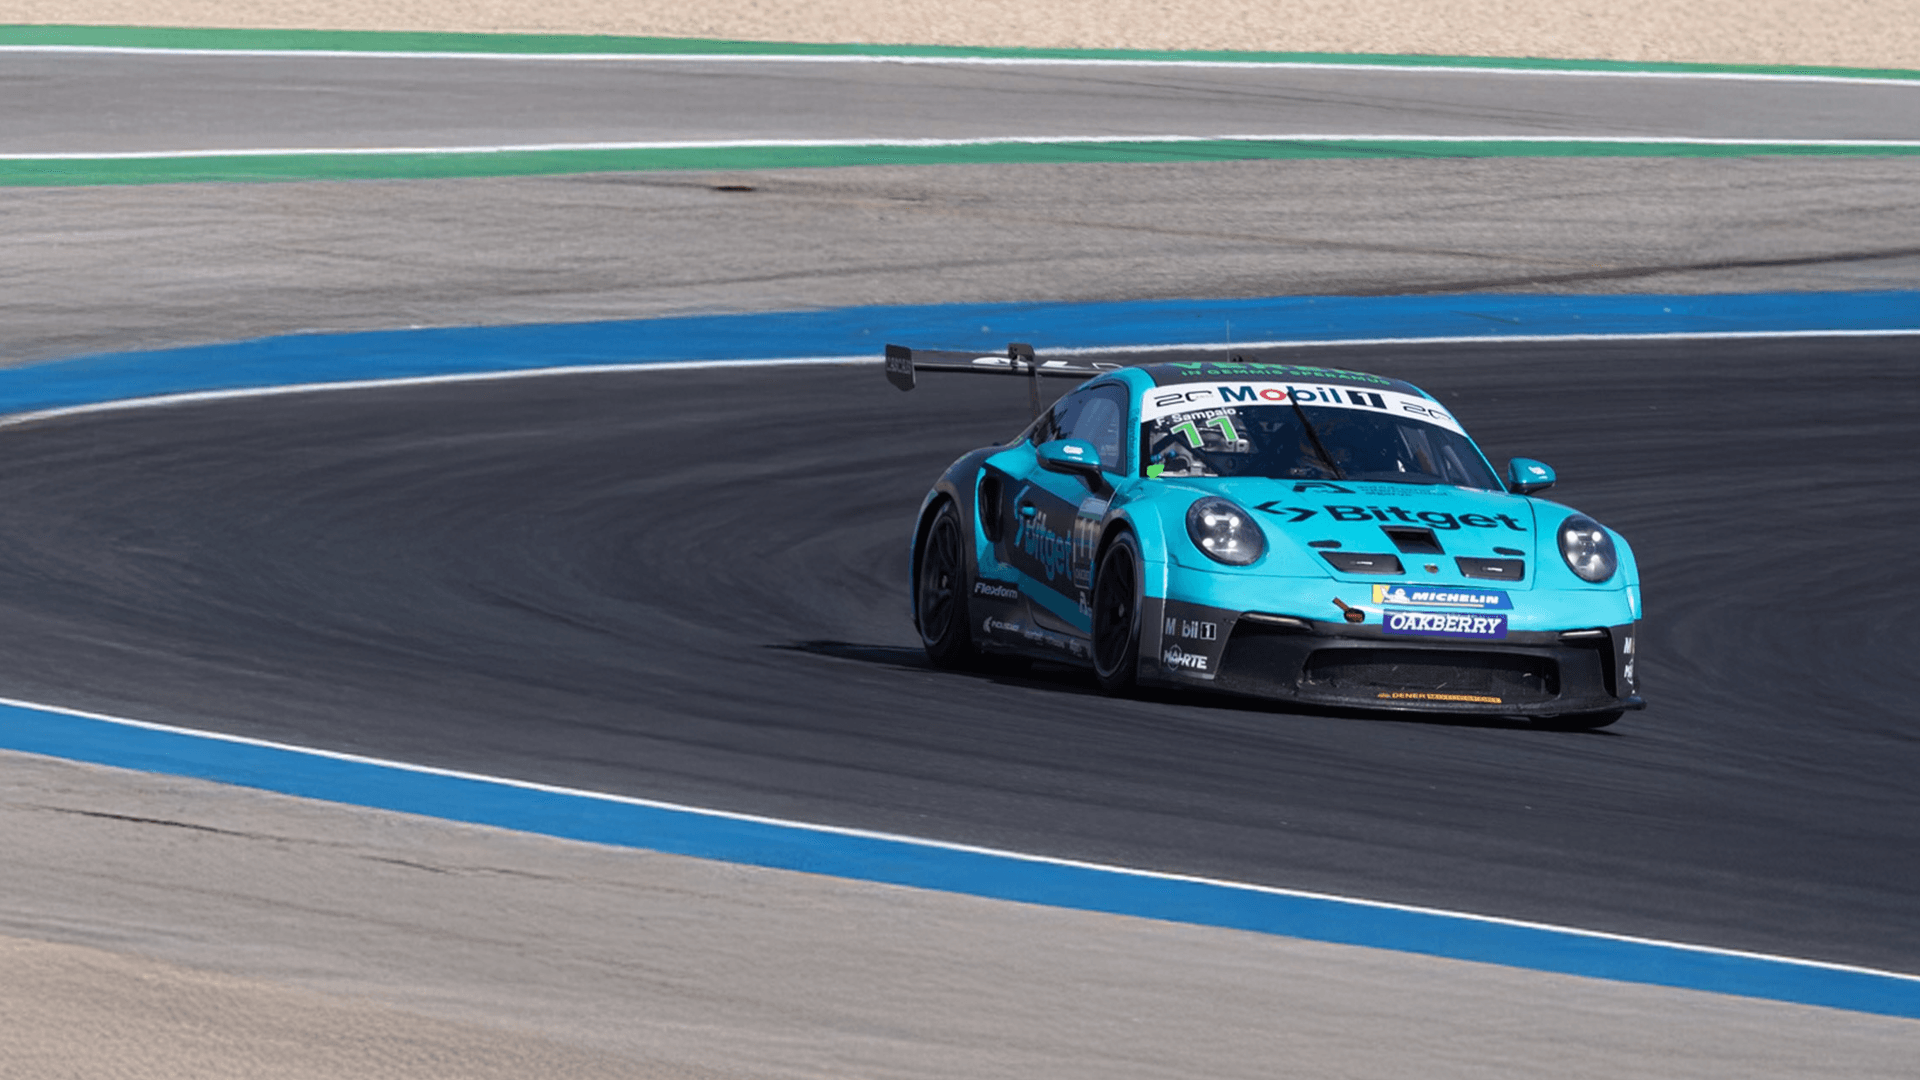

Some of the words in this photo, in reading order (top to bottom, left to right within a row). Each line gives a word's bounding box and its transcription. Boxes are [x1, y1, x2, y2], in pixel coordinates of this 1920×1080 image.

[1217, 385, 1343, 404] Mobil
[1171, 406, 1237, 423] Sampaio
[1170, 415, 1239, 449] 11
[1323, 504, 1527, 532] Bitget
[974, 582, 1018, 600] Flexform
[1411, 591, 1499, 604] MICHELIN
[1165, 617, 1199, 639] Mbil
[1389, 612, 1502, 634] OAKBERRY
